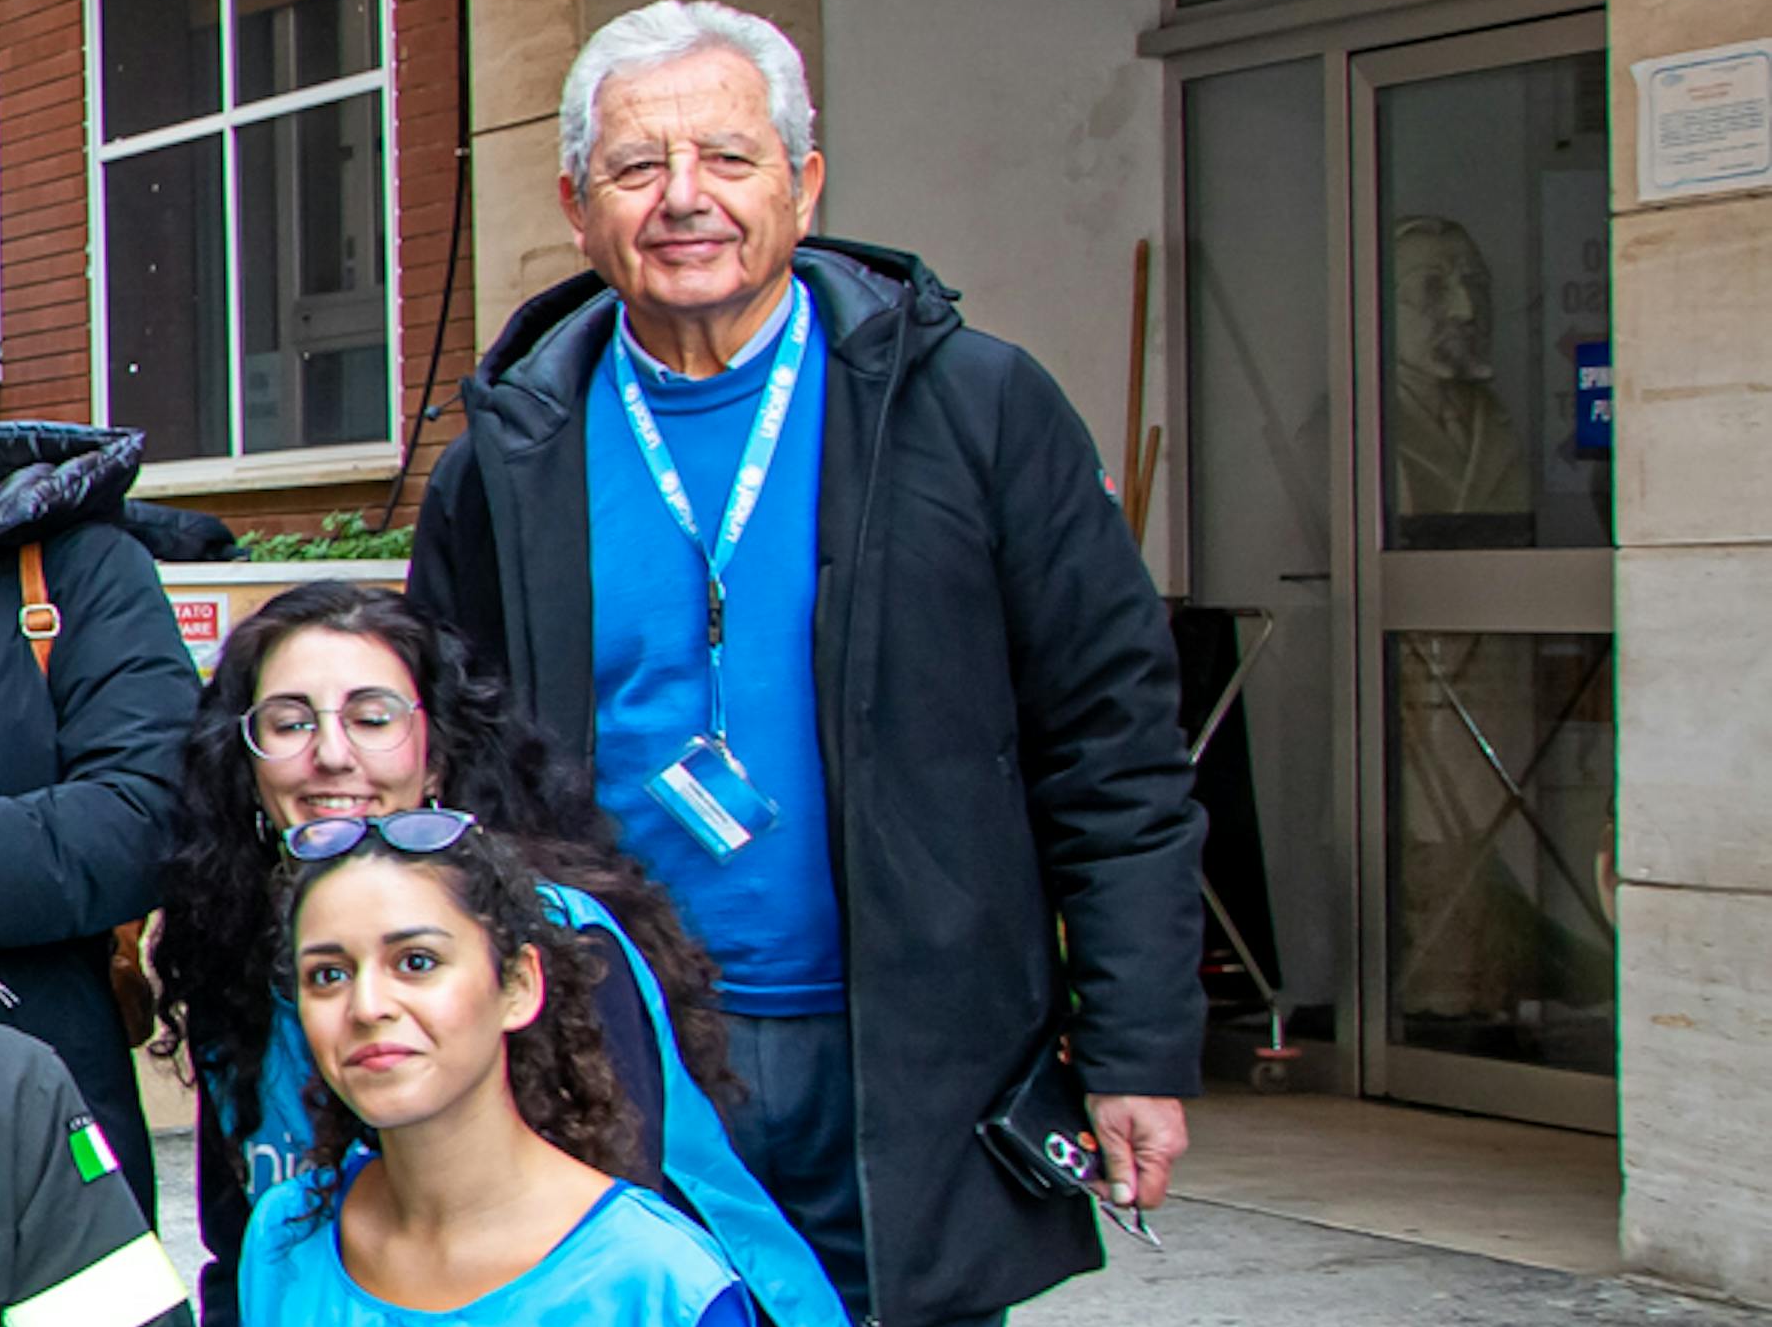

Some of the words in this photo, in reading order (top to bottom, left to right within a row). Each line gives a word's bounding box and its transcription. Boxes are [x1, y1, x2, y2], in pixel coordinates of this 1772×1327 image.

[723, 484, 759, 546] unicef
[174, 603, 215, 620] TATO
[181, 621, 213, 636] ARE
